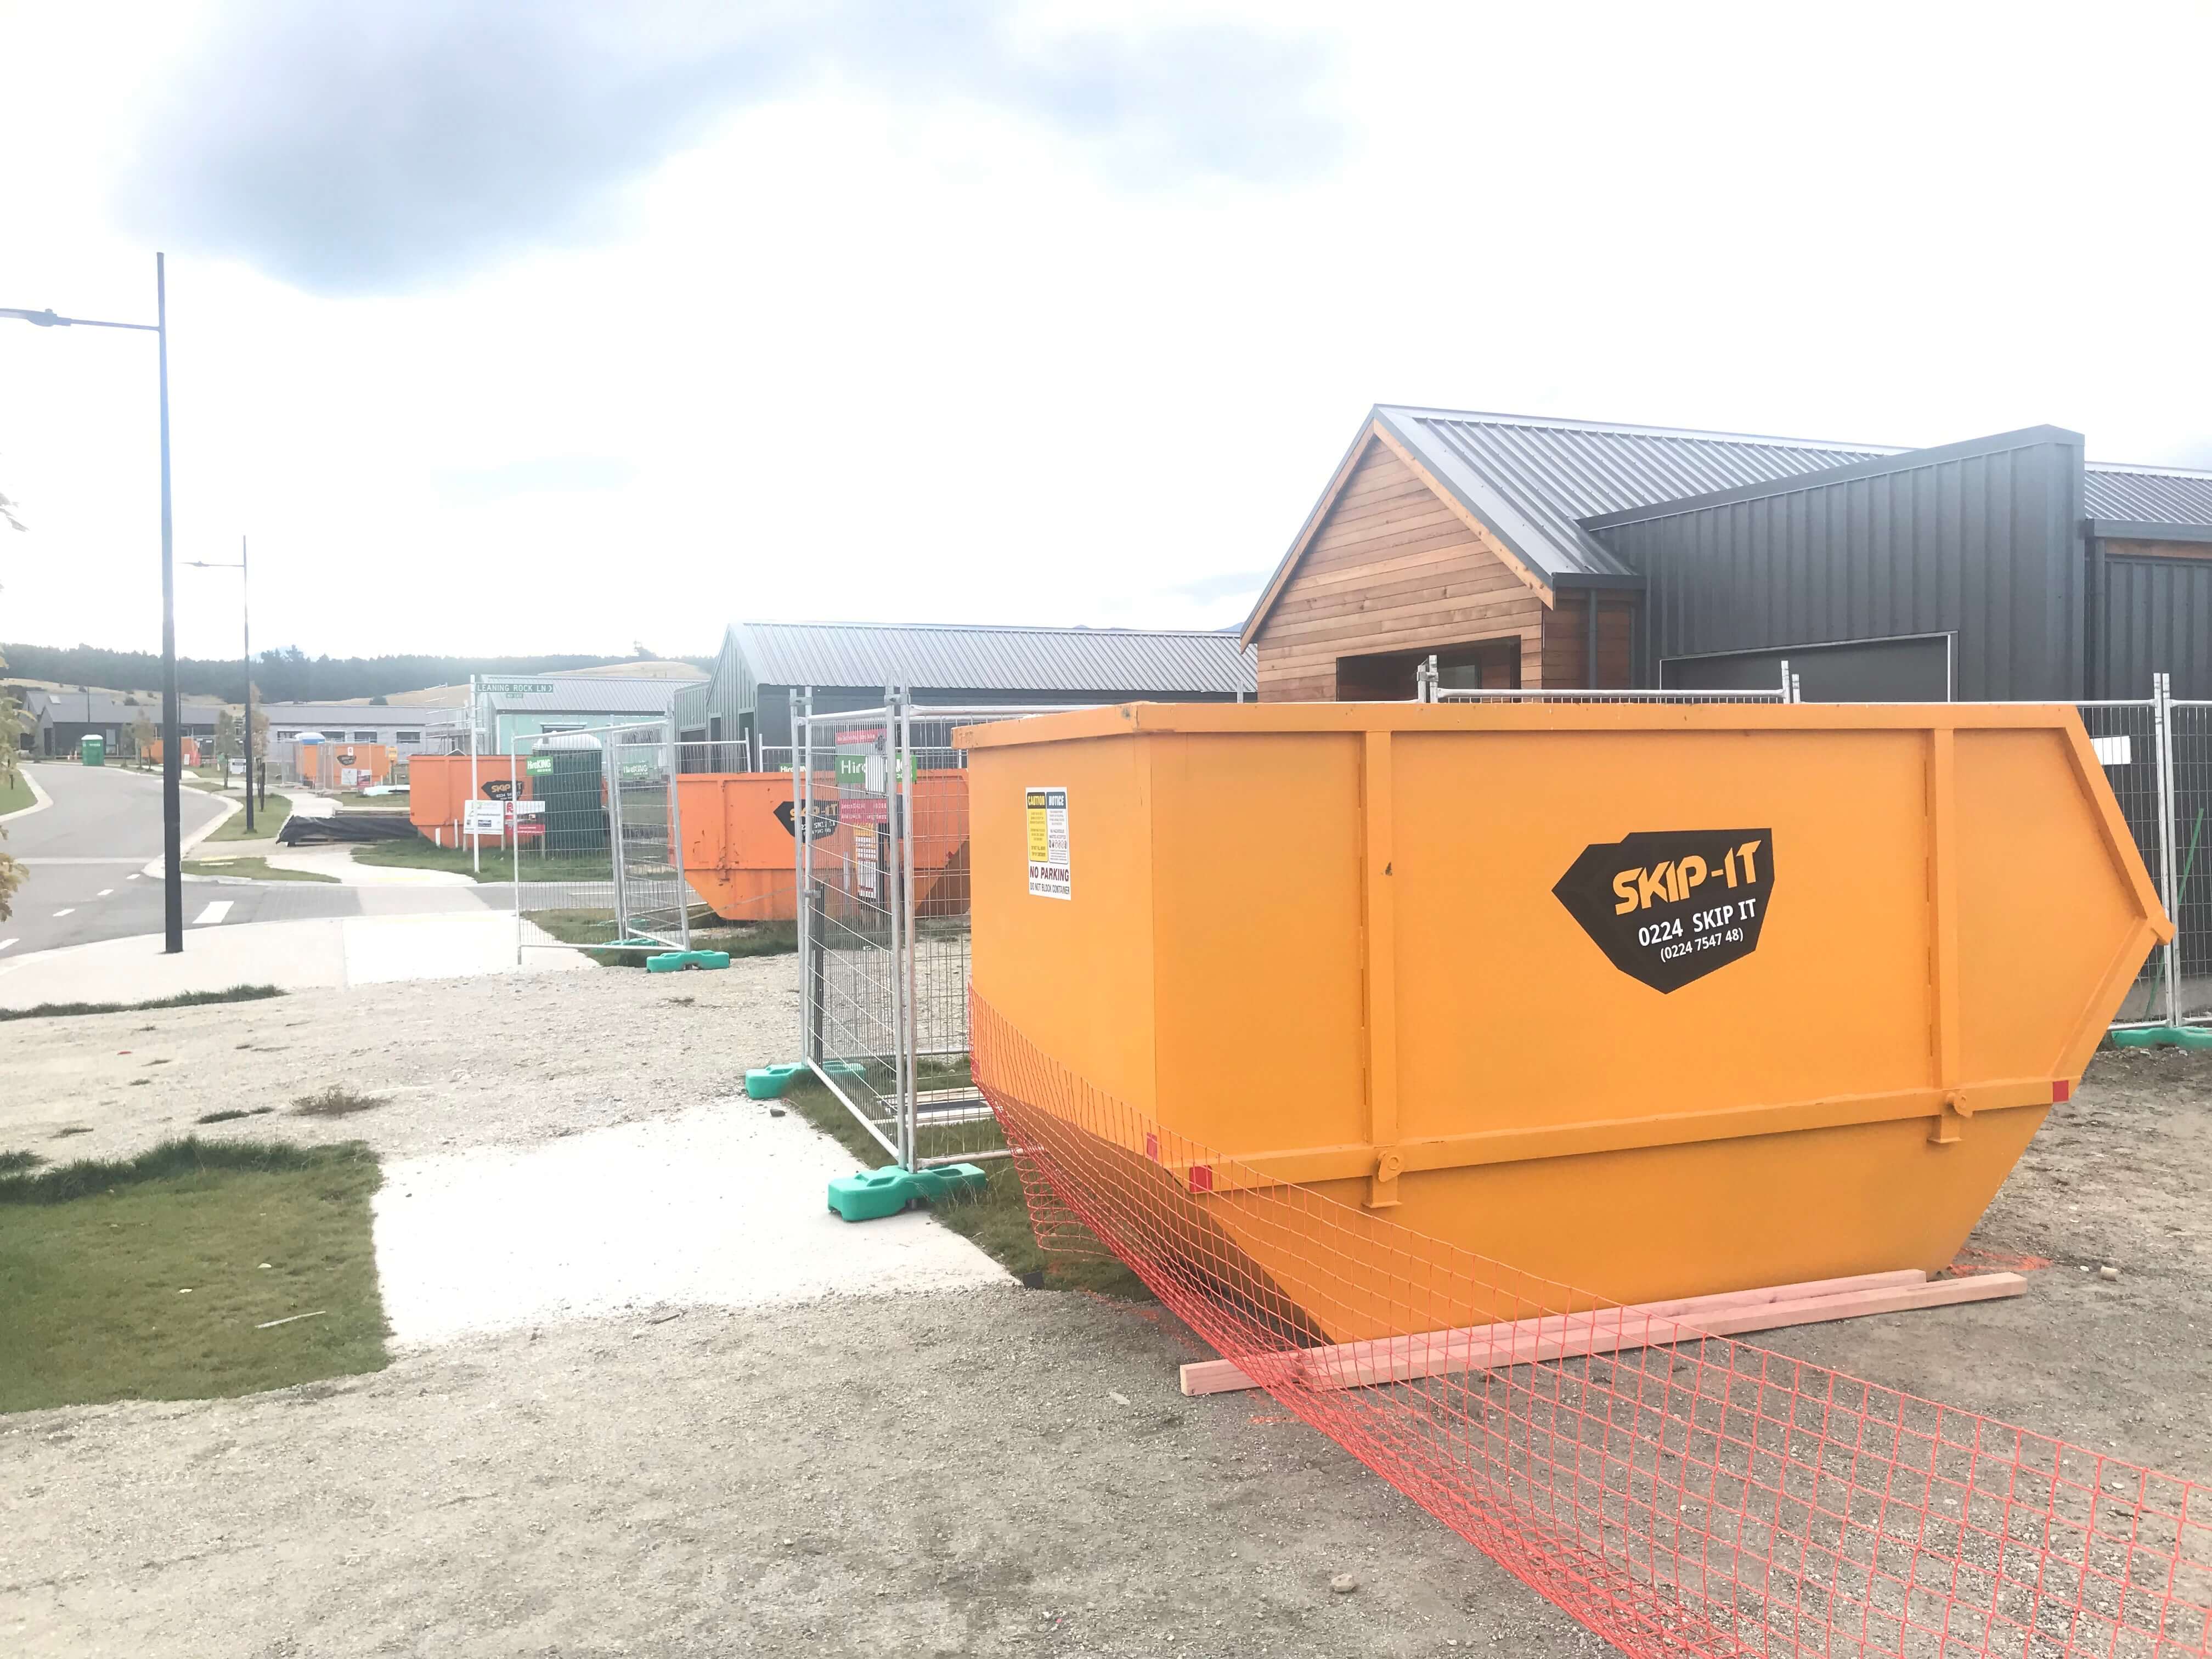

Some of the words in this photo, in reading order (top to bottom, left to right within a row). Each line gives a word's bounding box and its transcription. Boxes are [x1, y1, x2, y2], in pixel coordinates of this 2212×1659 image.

[1028, 795, 1045, 805] CAUTION
[1048, 795, 1064, 805] NOTICE
[1030, 866, 1039, 878] NO
[1041, 867, 1069, 882] PARKING
[1613, 840, 1761, 915] SKIP-IT
[1042, 884, 1052, 892] BLOCK
[1052, 885, 1070, 894] CONTAINER
[1638, 918, 1683, 946] 0224
[1692, 905, 1734, 932] SKIP
[1738, 899, 1756, 920] IT
[1660, 941, 1693, 962] (0224
[1694, 933, 1722, 951] 7547
[1725, 928, 1743, 943] 48)
